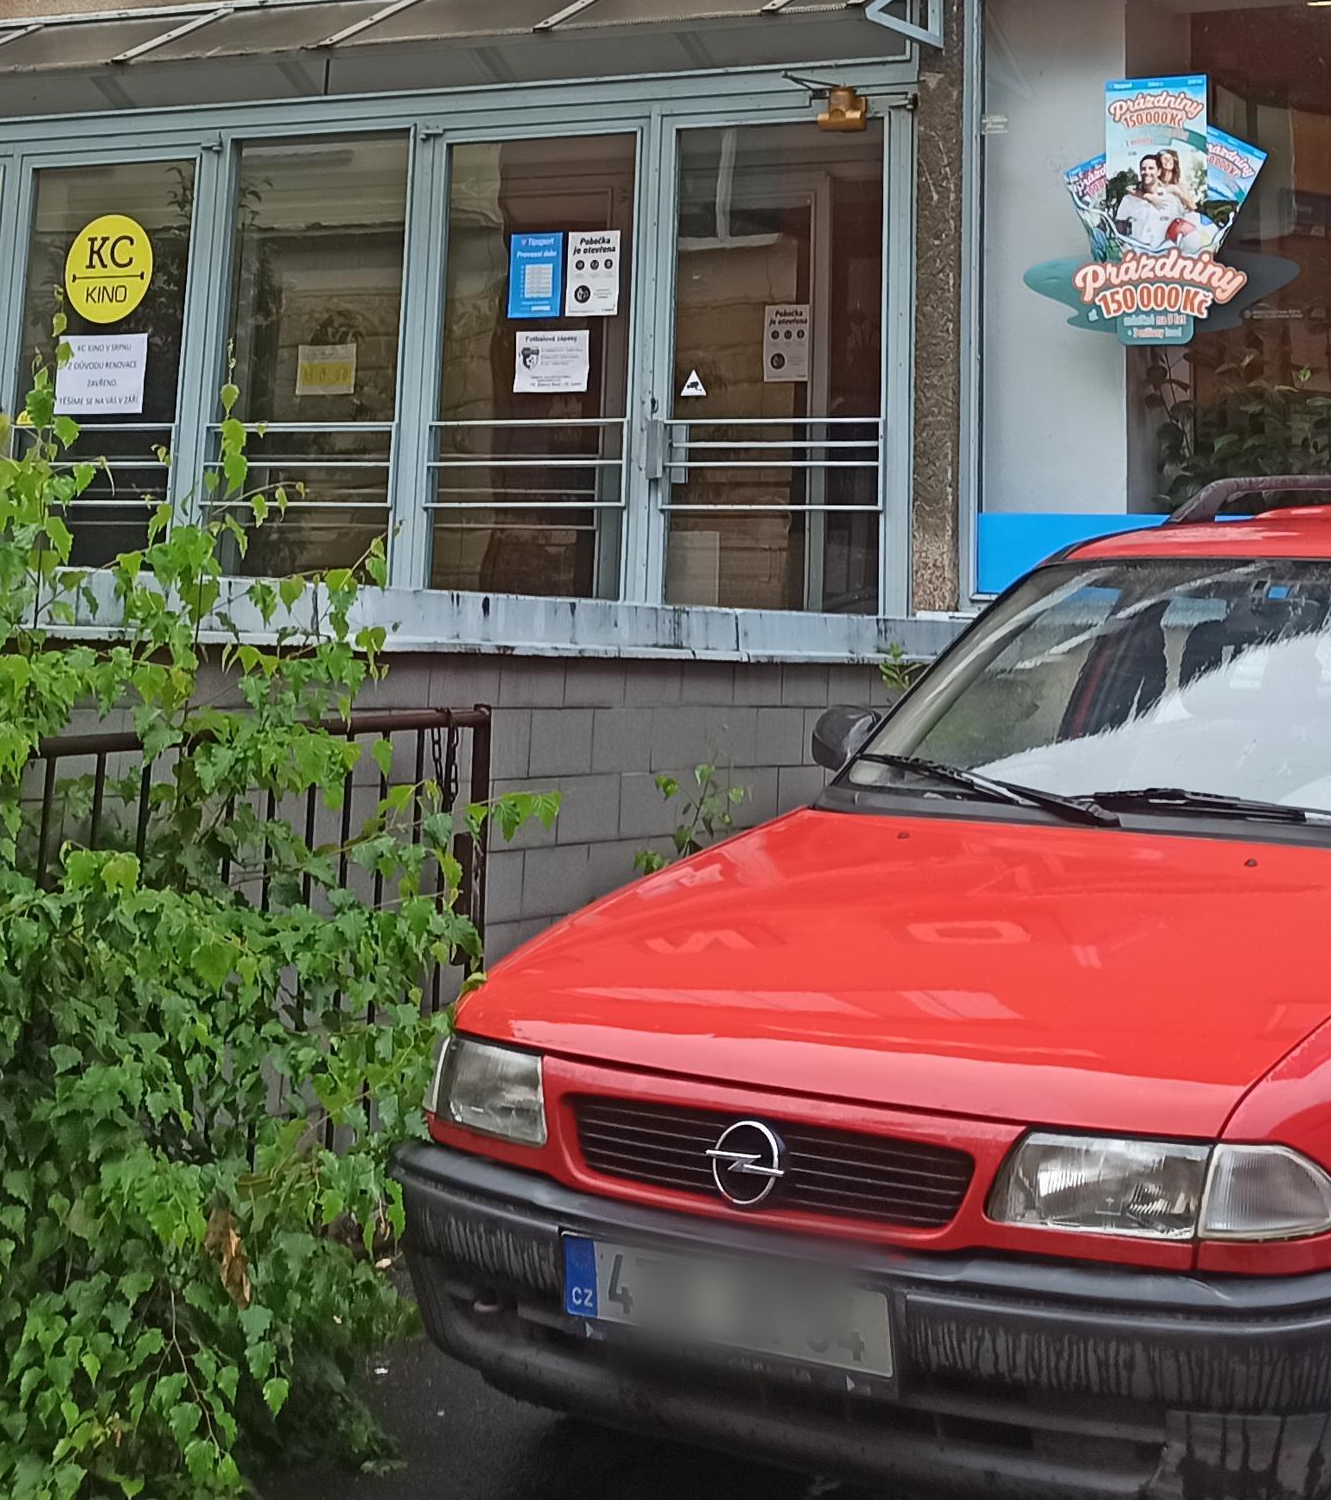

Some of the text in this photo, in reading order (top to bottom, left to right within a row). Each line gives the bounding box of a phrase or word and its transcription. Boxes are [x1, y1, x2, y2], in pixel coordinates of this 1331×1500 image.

[1109, 90, 1204, 123] Prázdniny
[573, 245, 616, 256] je otevřena
[579, 236, 611, 246] Pobočka
[85, 235, 135, 270] KC
[1074, 247, 1247, 304] Prázdniny
[85, 285, 128, 304] KINO
[1095, 286, 1136, 318] 150
[1138, 283, 1181, 312] 000
[1181, 284, 1213, 318] Kč
[86, 378, 116, 387] ZAVŘENO
[571, 1286, 594, 1308] CZ
